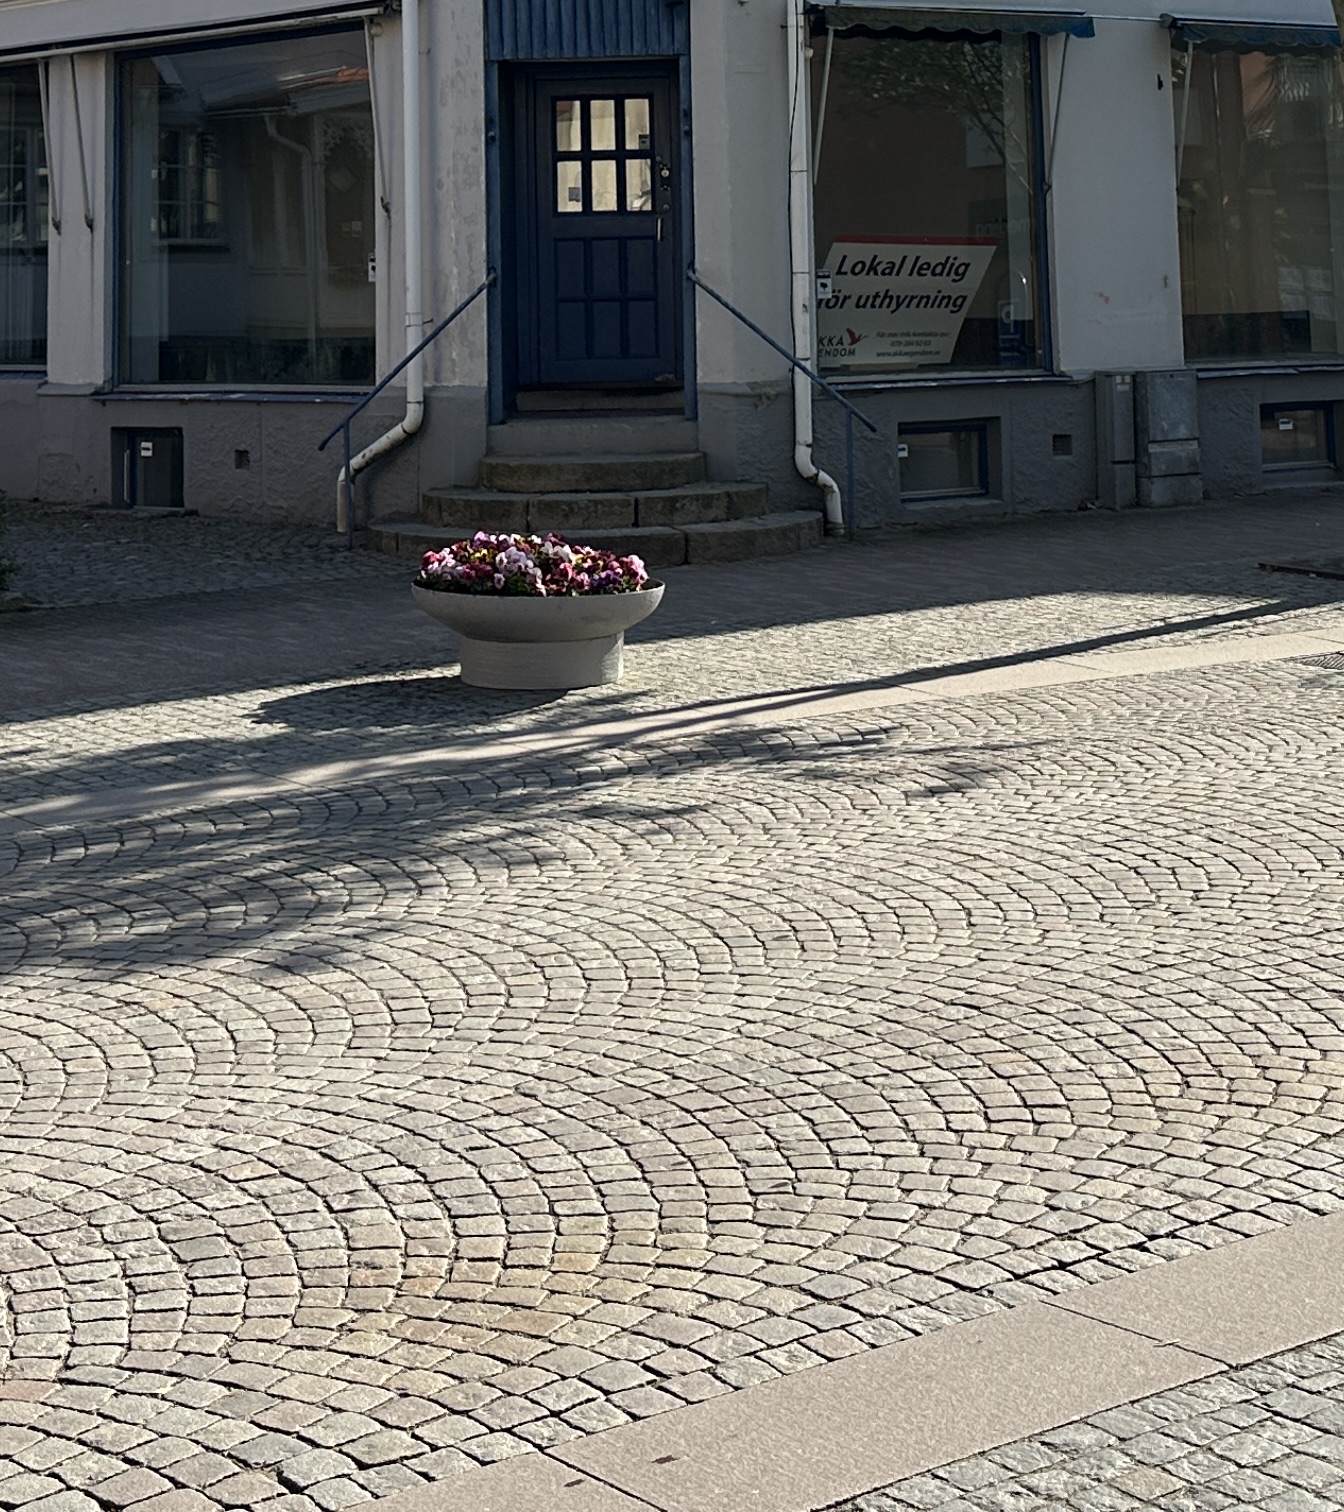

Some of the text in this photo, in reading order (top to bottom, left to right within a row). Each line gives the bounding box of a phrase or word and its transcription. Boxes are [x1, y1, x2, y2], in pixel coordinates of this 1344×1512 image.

[835, 255, 971, 283] Lokal ledig
[855, 289, 968, 314] uthyrning
[818, 335, 843, 347] KKA
